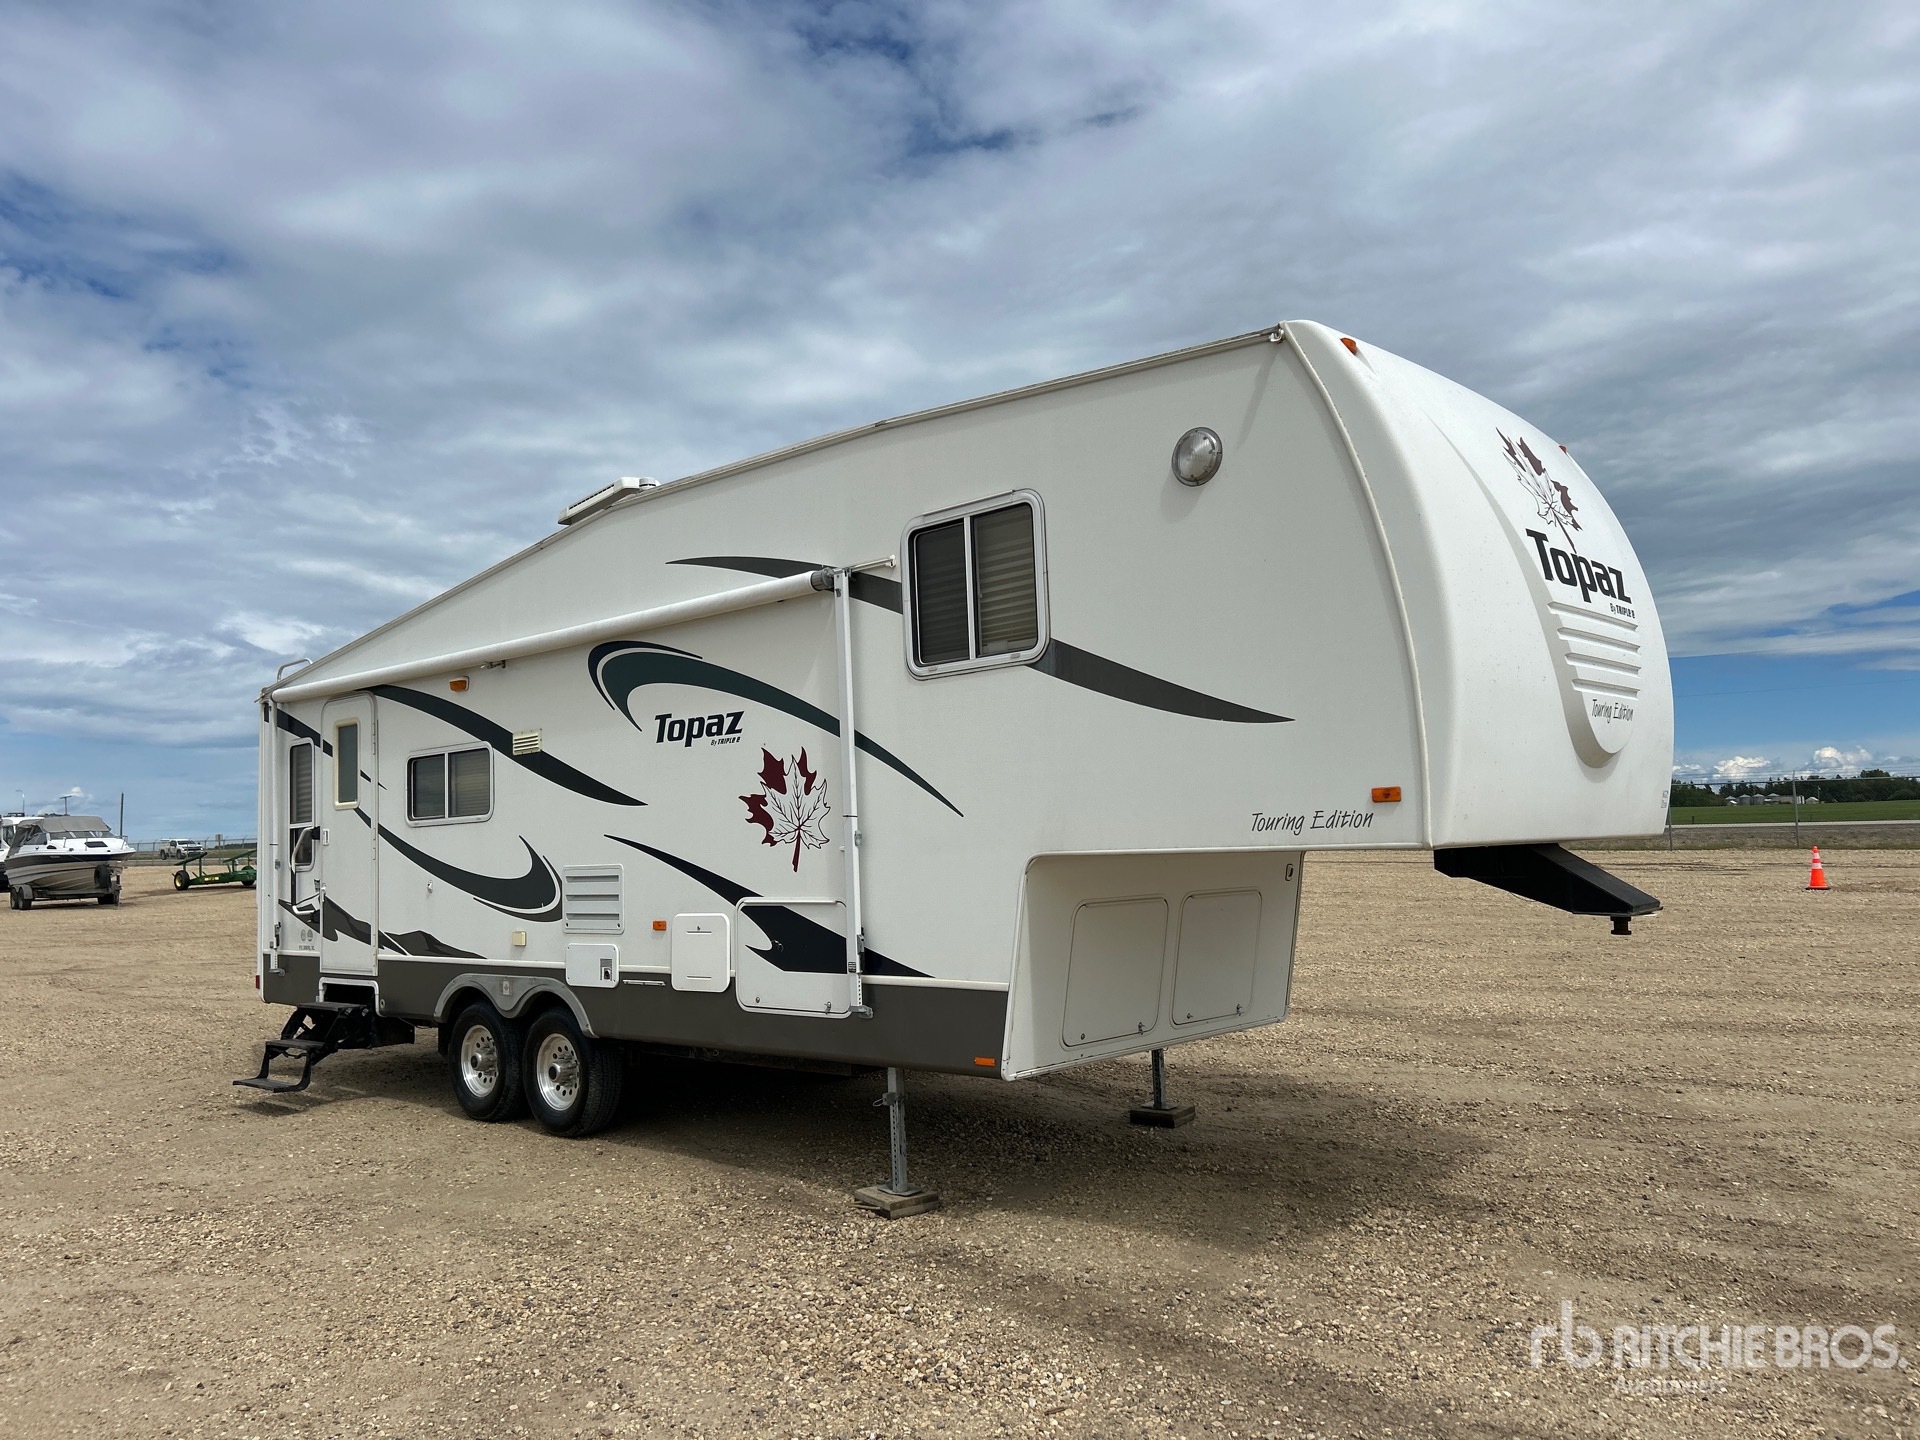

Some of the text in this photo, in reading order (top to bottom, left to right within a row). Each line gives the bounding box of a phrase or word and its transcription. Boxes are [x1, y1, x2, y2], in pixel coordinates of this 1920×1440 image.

[1525, 528, 1633, 604] Topaz
[1592, 698, 1634, 724] Touring Edition
[655, 711, 745, 748] Topaz
[710, 739, 718, 747] By
[1251, 809, 1375, 836] Touring Edition
